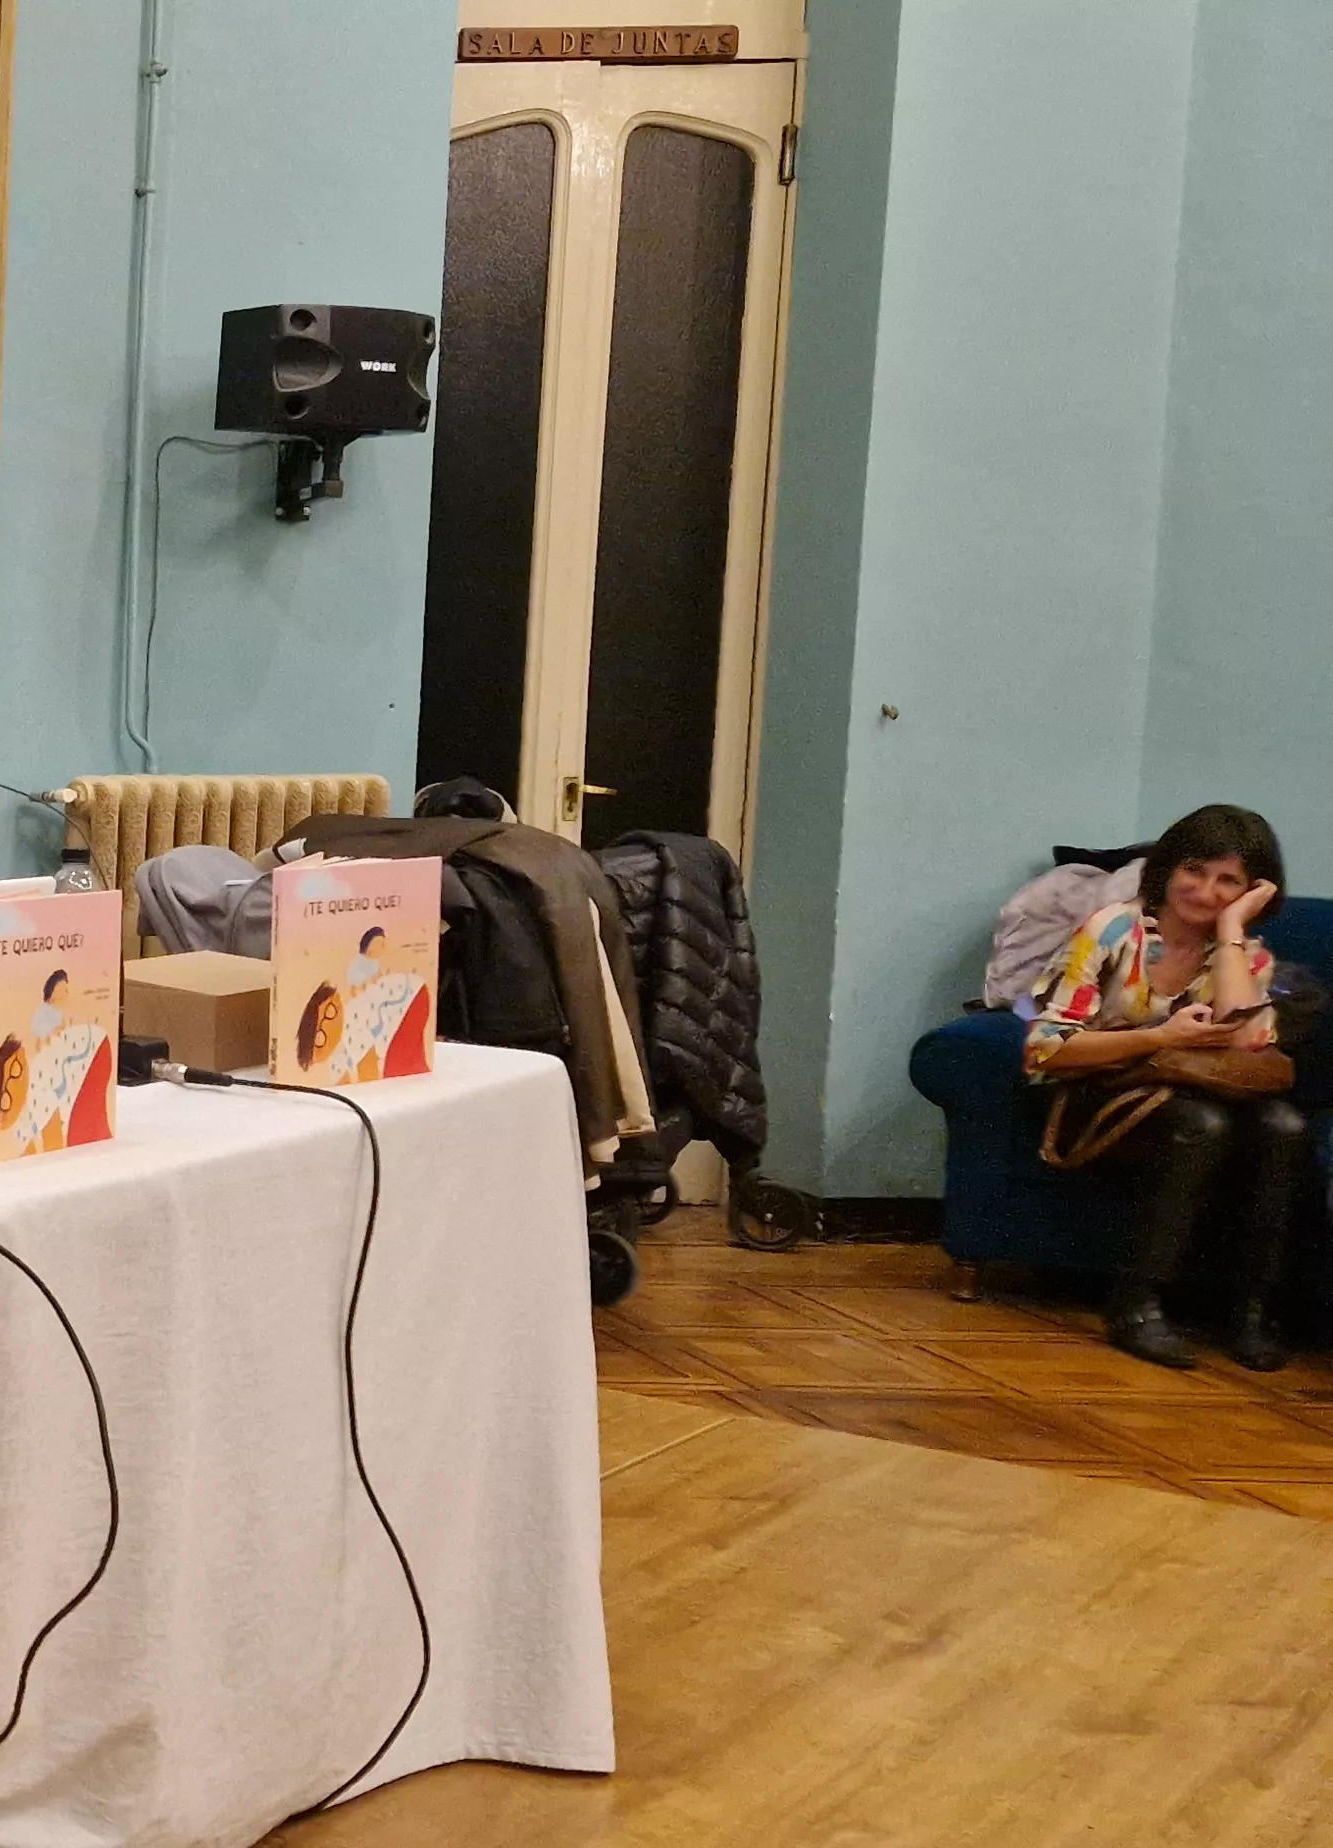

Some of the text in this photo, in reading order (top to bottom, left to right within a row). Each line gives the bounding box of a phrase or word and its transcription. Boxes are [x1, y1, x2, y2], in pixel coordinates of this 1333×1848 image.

[469, 30, 733, 55] SALA DE JUNTAS
[360, 360, 397, 372] WORK
[329, 897, 369, 915] QUIERO
[13, 936, 53, 955] QUIERO
